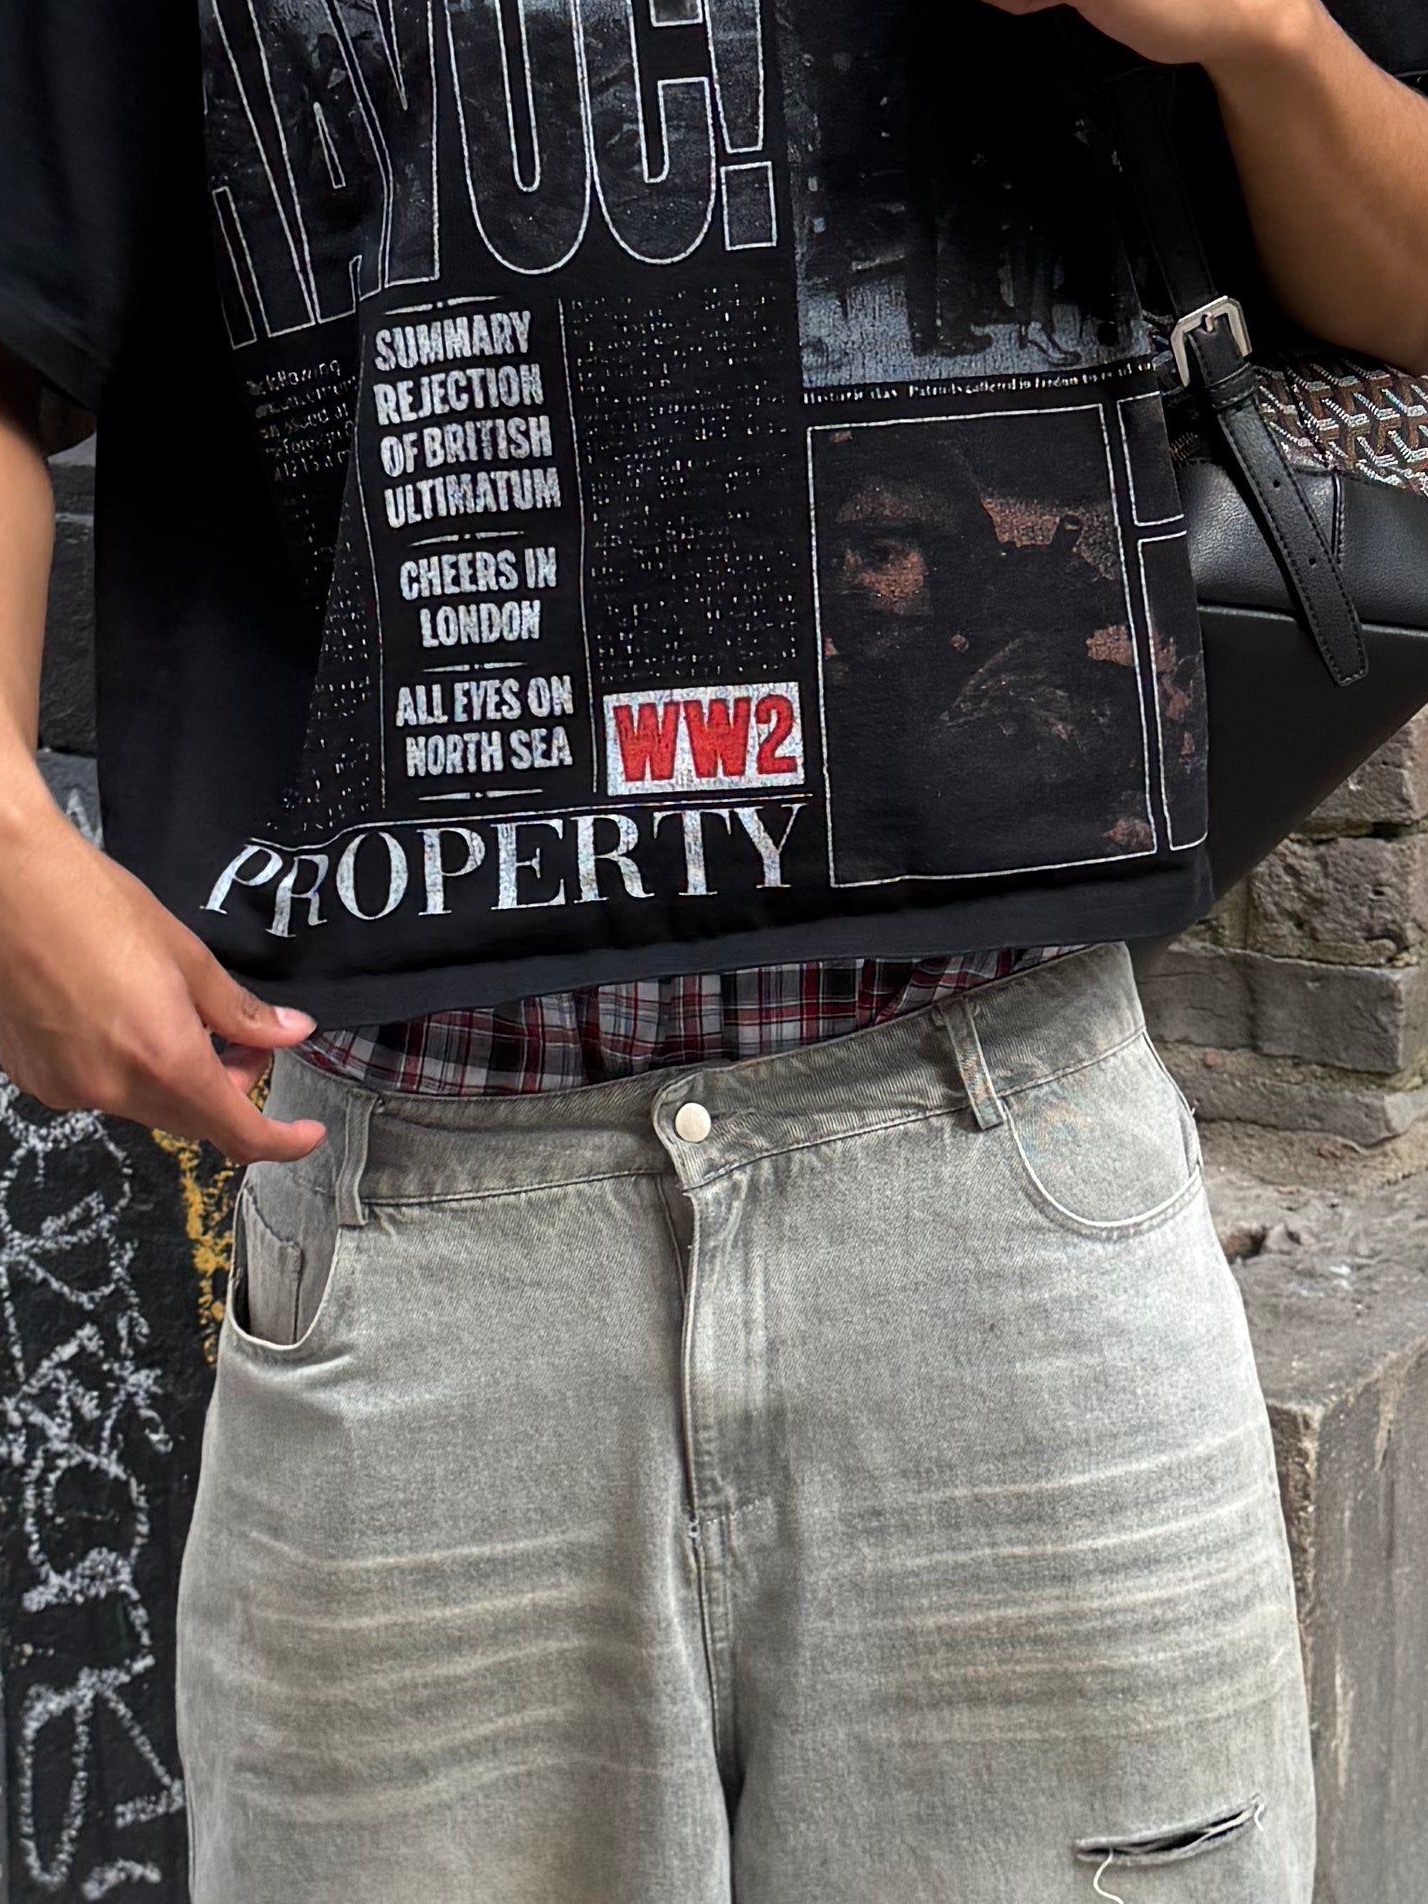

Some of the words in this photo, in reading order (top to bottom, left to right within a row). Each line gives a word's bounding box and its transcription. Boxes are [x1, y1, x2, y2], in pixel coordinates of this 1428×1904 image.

[374, 310, 532, 372] SUMMARY
[372, 363, 545, 426] REJECTION
[380, 432, 419, 478] OF
[422, 415, 554, 466] BRITISH
[383, 467, 562, 530] ULTIMATUM
[398, 548, 518, 601] CHEERS
[524, 546, 558, 589] IN
[418, 599, 542, 649] LONDON
[395, 683, 449, 728] ALL
[453, 677, 522, 724] EYES
[526, 674, 575, 717] ON
[404, 730, 503, 779] NORTH
[508, 725, 574, 770] SEA
[611, 693, 800, 784] WW2
[199, 802, 807, 938] PROPERTY
